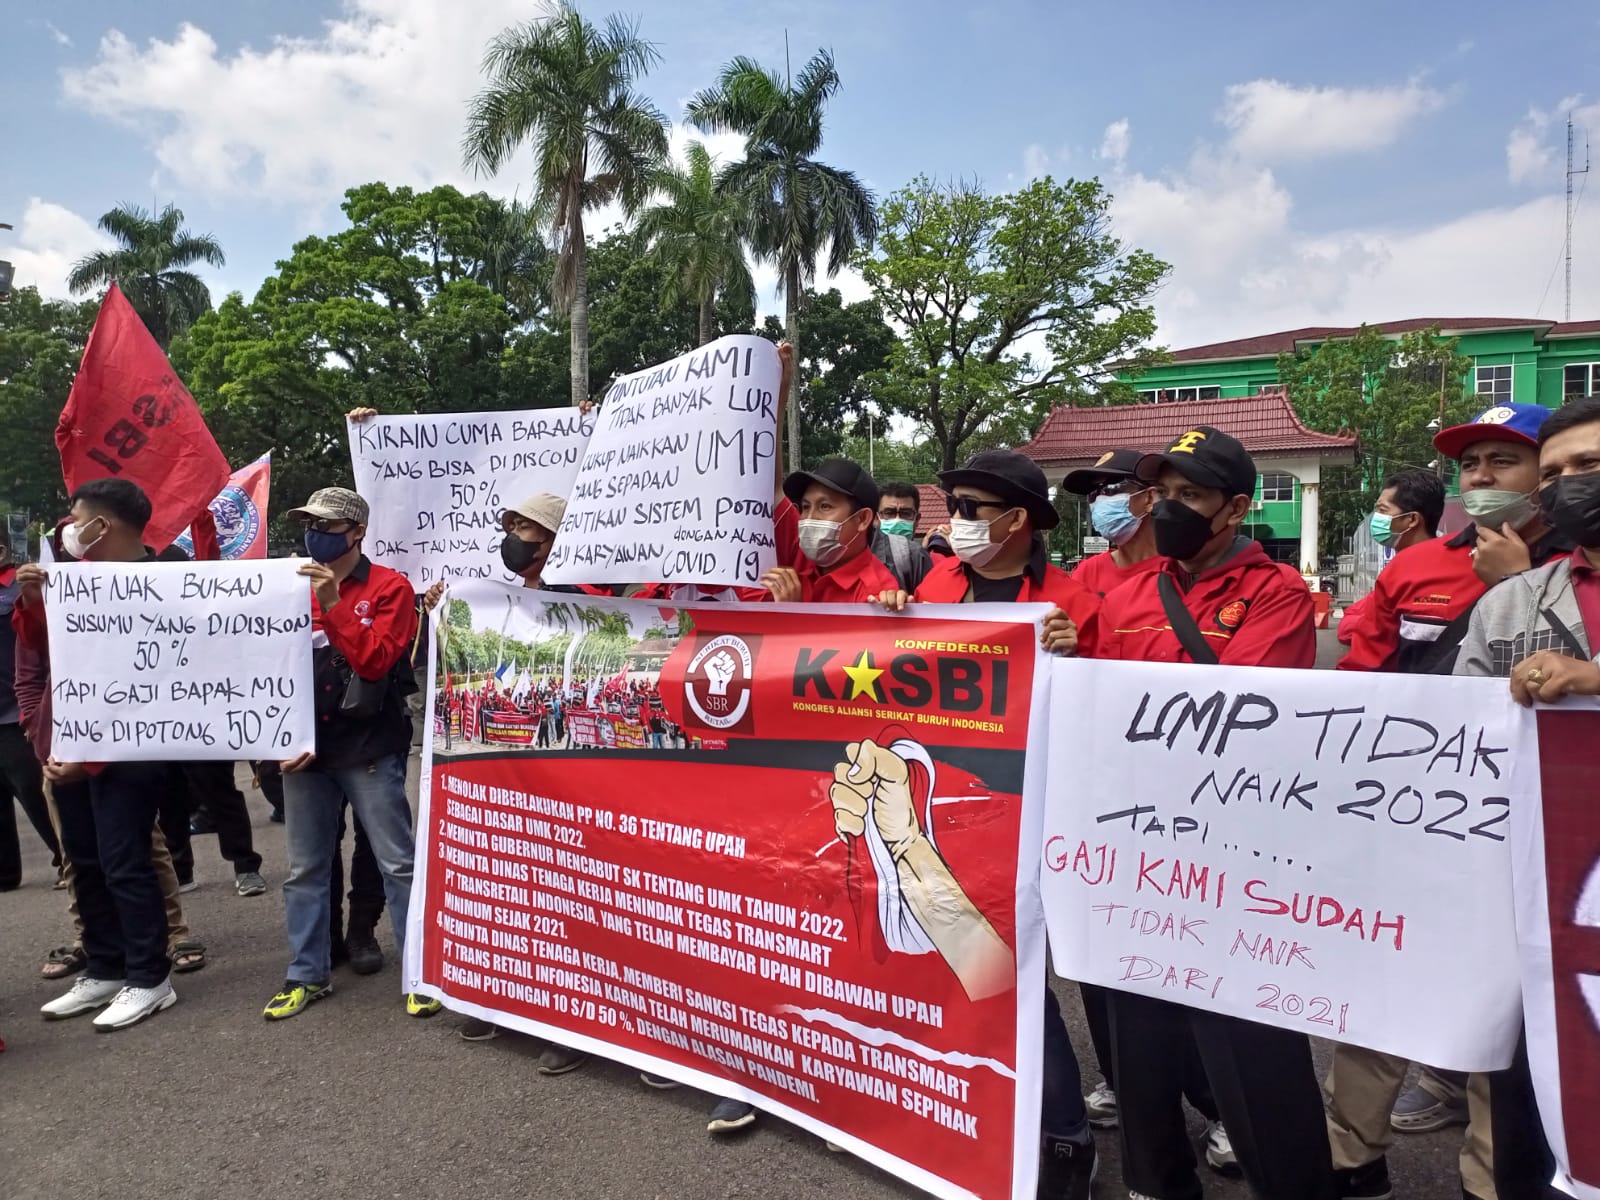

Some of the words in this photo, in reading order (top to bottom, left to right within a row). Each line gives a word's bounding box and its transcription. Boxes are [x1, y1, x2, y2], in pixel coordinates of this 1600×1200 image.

[606, 363, 680, 406] TUNTUTAN
[685, 347, 752, 382] KAMI
[609, 400, 645, 431] TIDAK
[652, 385, 713, 419] BANYAK
[729, 385, 776, 424] LUR
[358, 423, 438, 453] KIRAIN
[446, 422, 502, 446] CUMA
[512, 415, 594, 442] BARANG
[581, 450, 616, 472] CUKUP
[617, 432, 689, 465] NAIKKAN
[695, 428, 775, 476] UMP
[371, 460, 422, 480] YANG
[429, 460, 475, 478] BISA
[607, 466, 679, 499] SEPADAN
[417, 511, 434, 530] DI
[633, 496, 702, 525] SISTEM
[375, 540, 408, 557] DAK
[730, 527, 775, 548] ALASAN
[421, 566, 433, 582] DI
[574, 542, 664, 569] KARYAWAN
[735, 549, 760, 581] 19
[45, 570, 102, 604] MAAF
[110, 574, 163, 601] NAK
[181, 572, 263, 600] BUKAN
[66, 613, 133, 634] SUSUMU
[140, 613, 196, 637] YANG
[208, 613, 310, 636] DIDISKON
[895, 639, 1009, 655] KONFEDERASI
[53, 679, 96, 704] TAPI
[104, 681, 159, 704] GAJI
[171, 677, 245, 706] BAPAK
[252, 677, 294, 698] MU
[706, 696, 728, 711] SBR
[792, 647, 1009, 717] KASBI
[53, 716, 103, 742] YANG
[111, 721, 216, 747] DIPOTONG
[226, 705, 292, 750] 50%
[792, 701, 835, 714] KONGRES
[837, 706, 873, 718] ALIANSI
[875, 709, 914, 722] SERIKAT
[917, 713, 950, 727] BURUH
[952, 718, 1005, 734] INDONESIA
[1125, 690, 1279, 758] UMP
[1295, 706, 1509, 781] TIDAK
[447, 798, 482, 824] SEBAGAI
[484, 809, 523, 833] DASAR
[526, 818, 552, 840] UMK
[553, 823, 586, 849] 2022.
[489, 786, 574, 822] DIBERLAKUKAN
[577, 804, 592, 824] PP
[595, 811, 616, 831] NO.
[619, 814, 638, 835] 36
[640, 817, 703, 848] TENTANG
[705, 831, 746, 859] UPAH
[1191, 767, 1319, 811] NAIK
[1337, 780, 1510, 842] 2022
[491, 834, 553, 862] GUBERNUR
[556, 849, 620, 883] MENCABUT
[623, 867, 641, 889] SK
[643, 872, 704, 905] TENTANG
[707, 888, 742, 915] UMK
[744, 896, 796, 928] TAHUN
[800, 910, 848, 942] 2022.
[1045, 835, 1117, 885] GAJI
[1136, 851, 1225, 909] KAMI
[1243, 879, 1406, 951] SUDAH
[445, 891, 492, 922] MINIMUM
[494, 906, 531, 931] SEJAK
[533, 917, 568, 940] 2021.
[492, 858, 529, 882] DINAS
[531, 865, 576, 894] TENAGA
[577, 878, 612, 906] KERJA
[615, 890, 683, 927] MENINDAK
[686, 909, 732, 940] TEGAS
[735, 922, 832, 968] TRANSMART
[1091, 902, 1209, 945] TIDAK
[1229, 929, 1316, 970] NAIK
[445, 868, 455, 887] PT
[456, 872, 529, 907] TRANSRETAIL
[533, 891, 599, 927] INDONESIA,
[600, 911, 632, 936] YANG
[634, 921, 673, 949] TELAH
[677, 933, 757, 975] MEMBAYAR
[759, 956, 801, 990] UPAH
[805, 970, 888, 1014] DIBAWAH
[891, 994, 943, 1029] UPAH
[491, 929, 529, 954] DINAS
[531, 938, 581, 967] TENAGA
[685, 988, 737, 1023] SANKSI
[740, 1006, 788, 1041] TEGAS
[791, 1025, 856, 1063] KEPADA
[859, 1045, 971, 1104] TRANSMART
[1120, 956, 1224, 998] DARI
[1256, 984, 1350, 1034] 2021
[442, 960, 482, 990] DENGAN
[484, 976, 550, 1009] POTONGAN
[552, 993, 568, 1013] 10
[570, 997, 596, 1021] S/D
[598, 1004, 617, 1026] 50
[636, 1017, 690, 1051] DENGAN
[691, 1040, 746, 1073] ALASAN
[747, 1059, 820, 1104] PANDEMI.
[443, 937, 453, 957] PT
[455, 942, 490, 969] TRANS
[493, 953, 533, 980] RETAIL
[536, 963, 603, 998] INFONESIA
[604, 982, 648, 1014] KARNA
[648, 998, 688, 1029] TELAH
[690, 1014, 795, 1069] MERUMAHKAN
[801, 1054, 898, 1112] KARYAWAN
[901, 1090, 979, 1140] SEPIHAK
